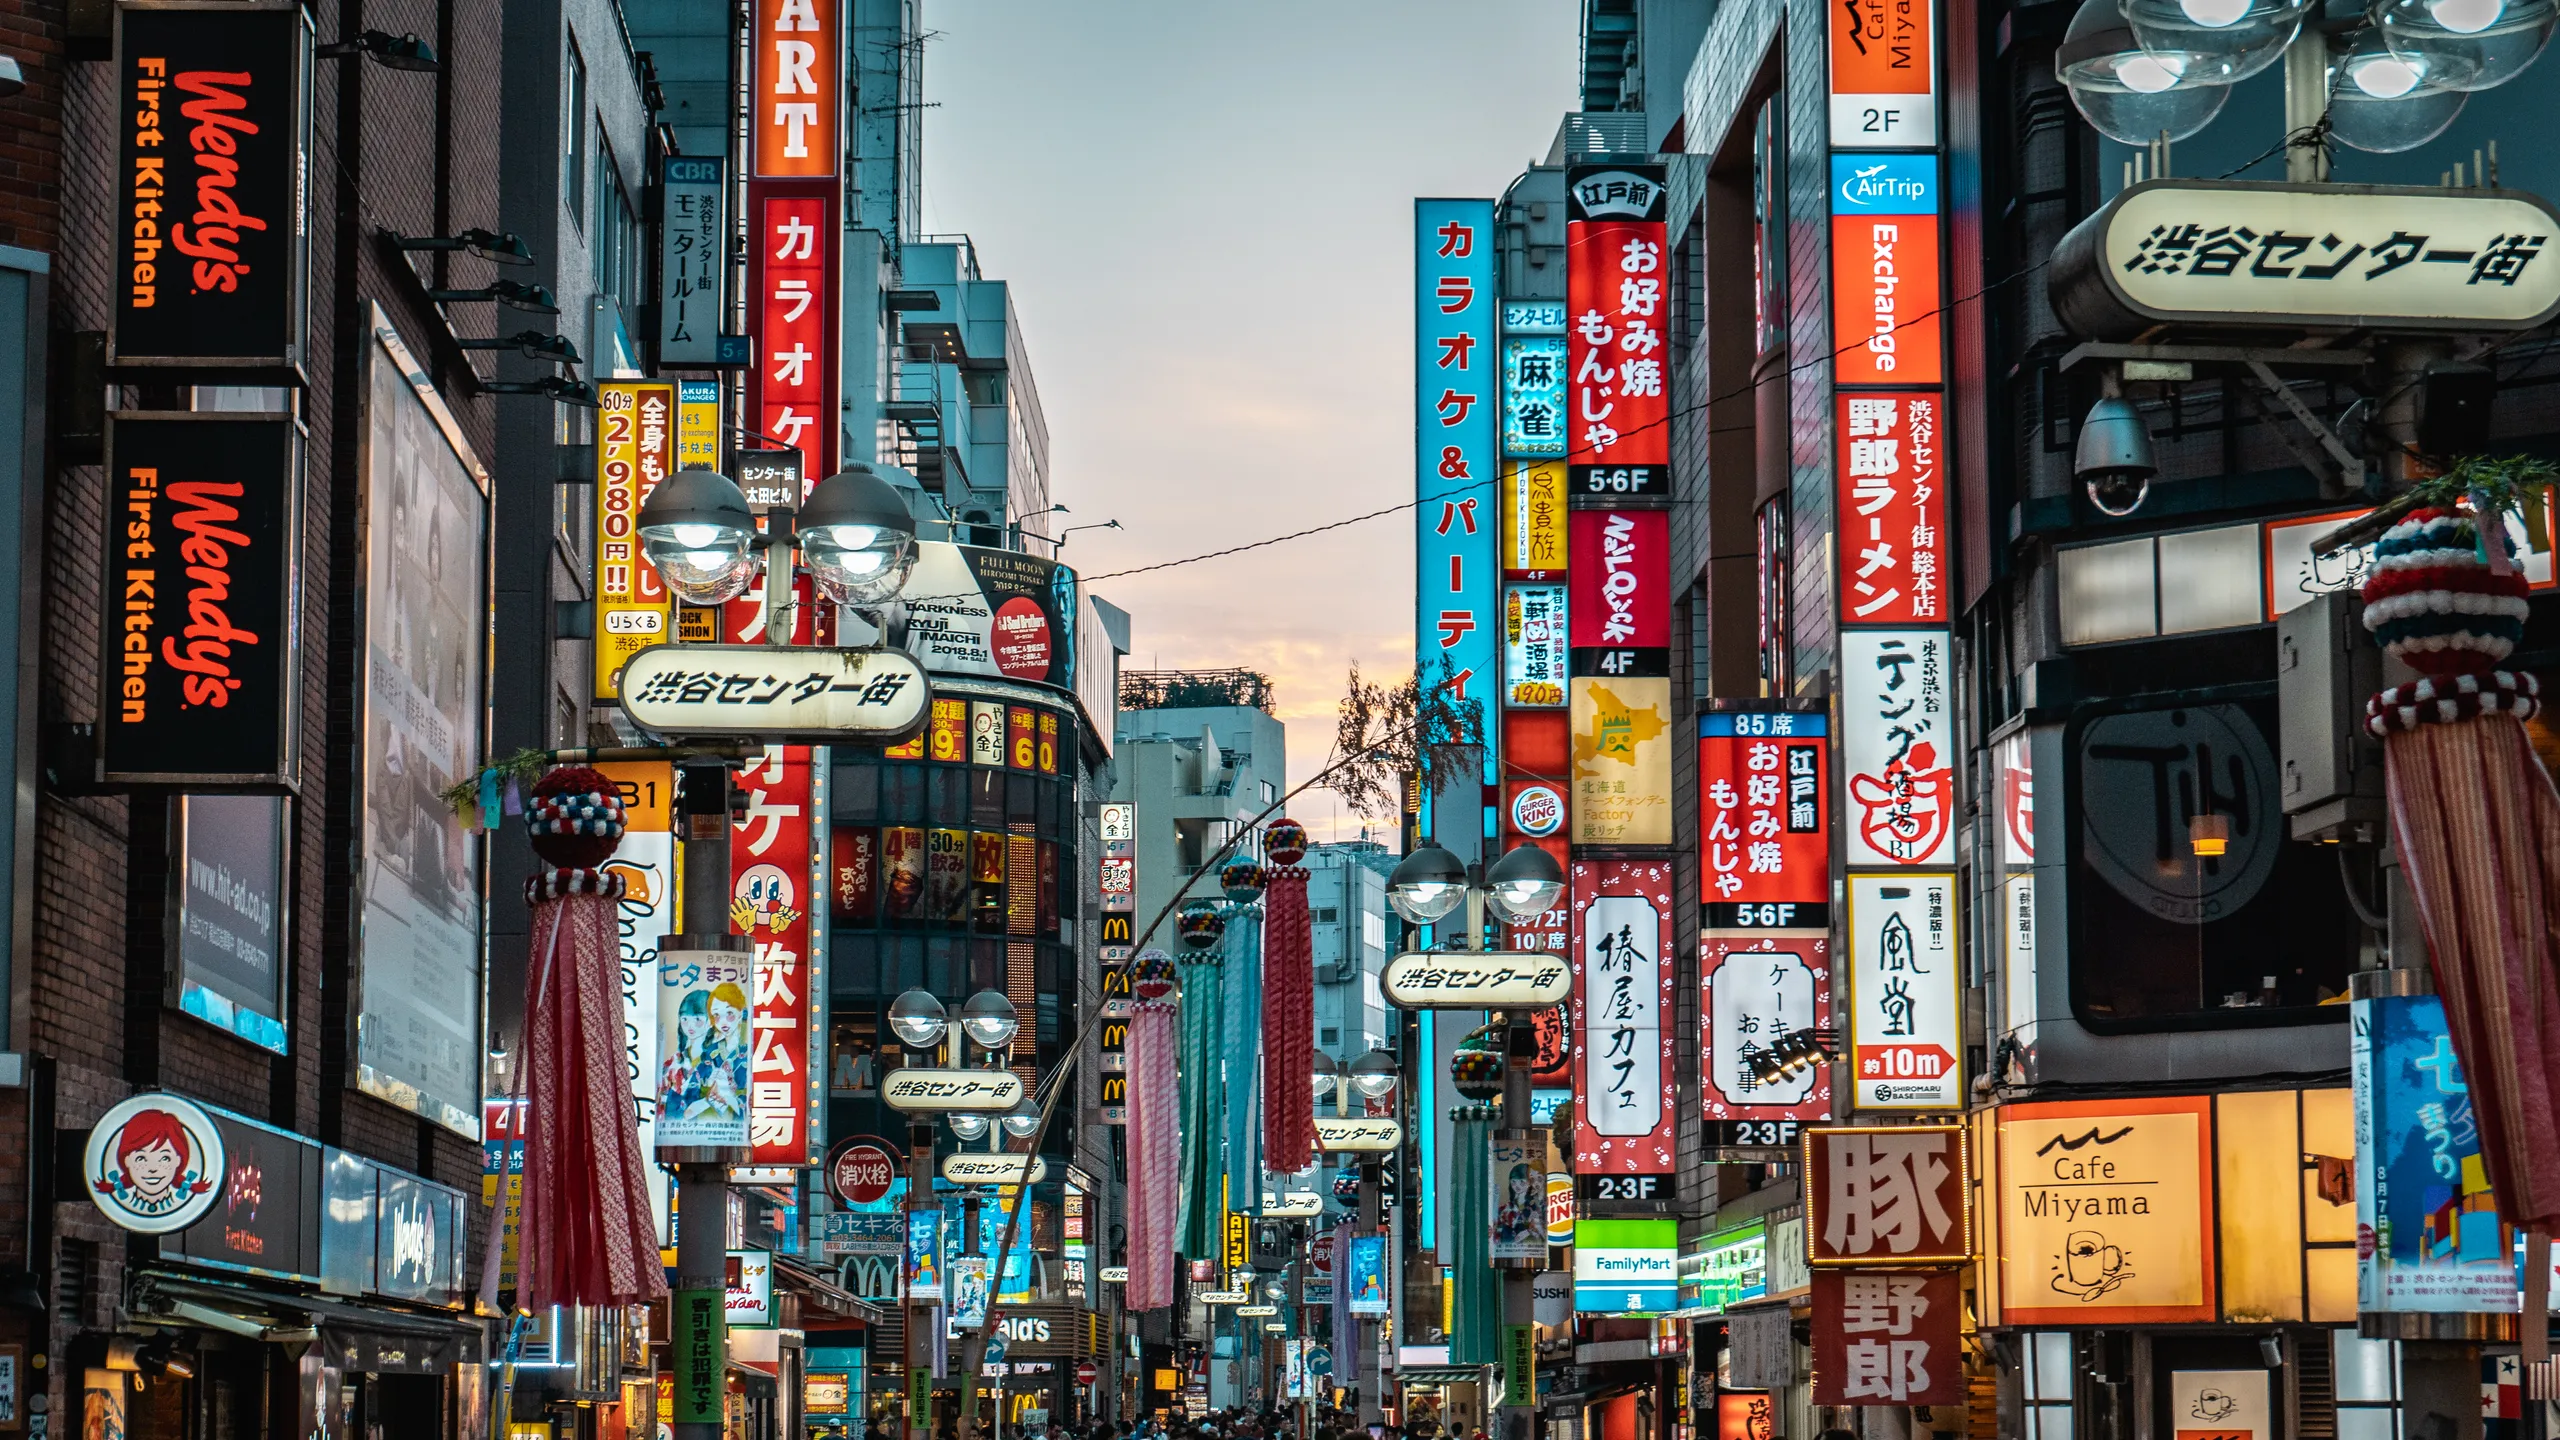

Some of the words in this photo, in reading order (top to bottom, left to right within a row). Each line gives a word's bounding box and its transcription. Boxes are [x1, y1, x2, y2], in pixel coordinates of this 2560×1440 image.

[136, 57, 166, 147] First
[1862, 109, 1900, 132] 2F
[171, 71, 267, 295] Wendy's
[670, 162, 716, 180] CBR
[1580, 181, 1650, 207] 江戸前
[1857, 177, 1925, 201] AirTrip
[132, 157, 164, 308] Kitchen
[697, 195, 714, 291] 渋谷センター街
[2124, 223, 2549, 287] 渋谷センター街
[671, 194, 696, 343] モニタールーム
[1868, 224, 1899, 371] Exchange
[1503, 310, 1566, 327] センタービル
[1620, 238, 1661, 397] お好み焼
[1577, 309, 1618, 453] もんじゃ
[603, 391, 632, 411] 60分
[1519, 355, 1552, 436] 麻雀
[743, 466, 795, 482] センター街
[746, 487, 793, 505] 太田ビル
[1848, 399, 1900, 617] 野郎ラーメン
[126, 467, 157, 559] First
[981, 556, 1011, 569] FULL
[1014, 561, 1045, 576] MOON
[1527, 571, 1546, 580] 4F
[162, 481, 258, 710] Wendy's
[610, 616, 657, 628] りらくる
[905, 603, 987, 618] DARKNESS
[122, 569, 156, 723] Kitchen
[919, 631, 980, 645] IMAICHI
[931, 644, 988, 658] 2018.8.1
[1601, 652, 1634, 674] 4F
[635, 671, 911, 707] 渋谷センター街
[992, 707, 1002, 762] やきとり
[1582, 781, 1626, 794] 北海道
[1790, 749, 1815, 829] 江戸前
[1520, 797, 1555, 813] BURGER
[1582, 794, 1667, 807] チーズフォンデュ
[1748, 741, 1784, 874] お好み焼
[1521, 806, 1556, 825] KING
[1584, 809, 1634, 822] Factory
[930, 831, 965, 852] 30分
[1709, 778, 1743, 898] もんじゃ
[659, 957, 701, 989] 七夕
[1879, 887, 1931, 1036] 一風堂
[705, 966, 749, 984] まつり
[1396, 967, 1563, 989] 渋谷センター街
[1596, 924, 1648, 1109] 椿屋カフェ
[890, 1081, 1016, 1098] 渋谷センター街
[1892, 1085, 1942, 1093] SHIROMARU
[2416, 1102, 2456, 1179] まつり
[841, 1164, 889, 1186] 消火栓
[2053, 1156, 2116, 1181] Cafe
[1823, 1133, 1954, 1256] 豚
[2024, 1190, 2152, 1222] Miyama
[845, 1214, 904, 1233] セキネ
[393, 1196, 424, 1284] Wendy's
[743, 1264, 766, 1277] ピザ
[1596, 1256, 1671, 1273] FamilyMart
[1626, 1293, 1643, 1310] 酒
[1843, 1275, 1932, 1401] 野郎
[691, 1298, 712, 1416] 客引きは犯罪です
